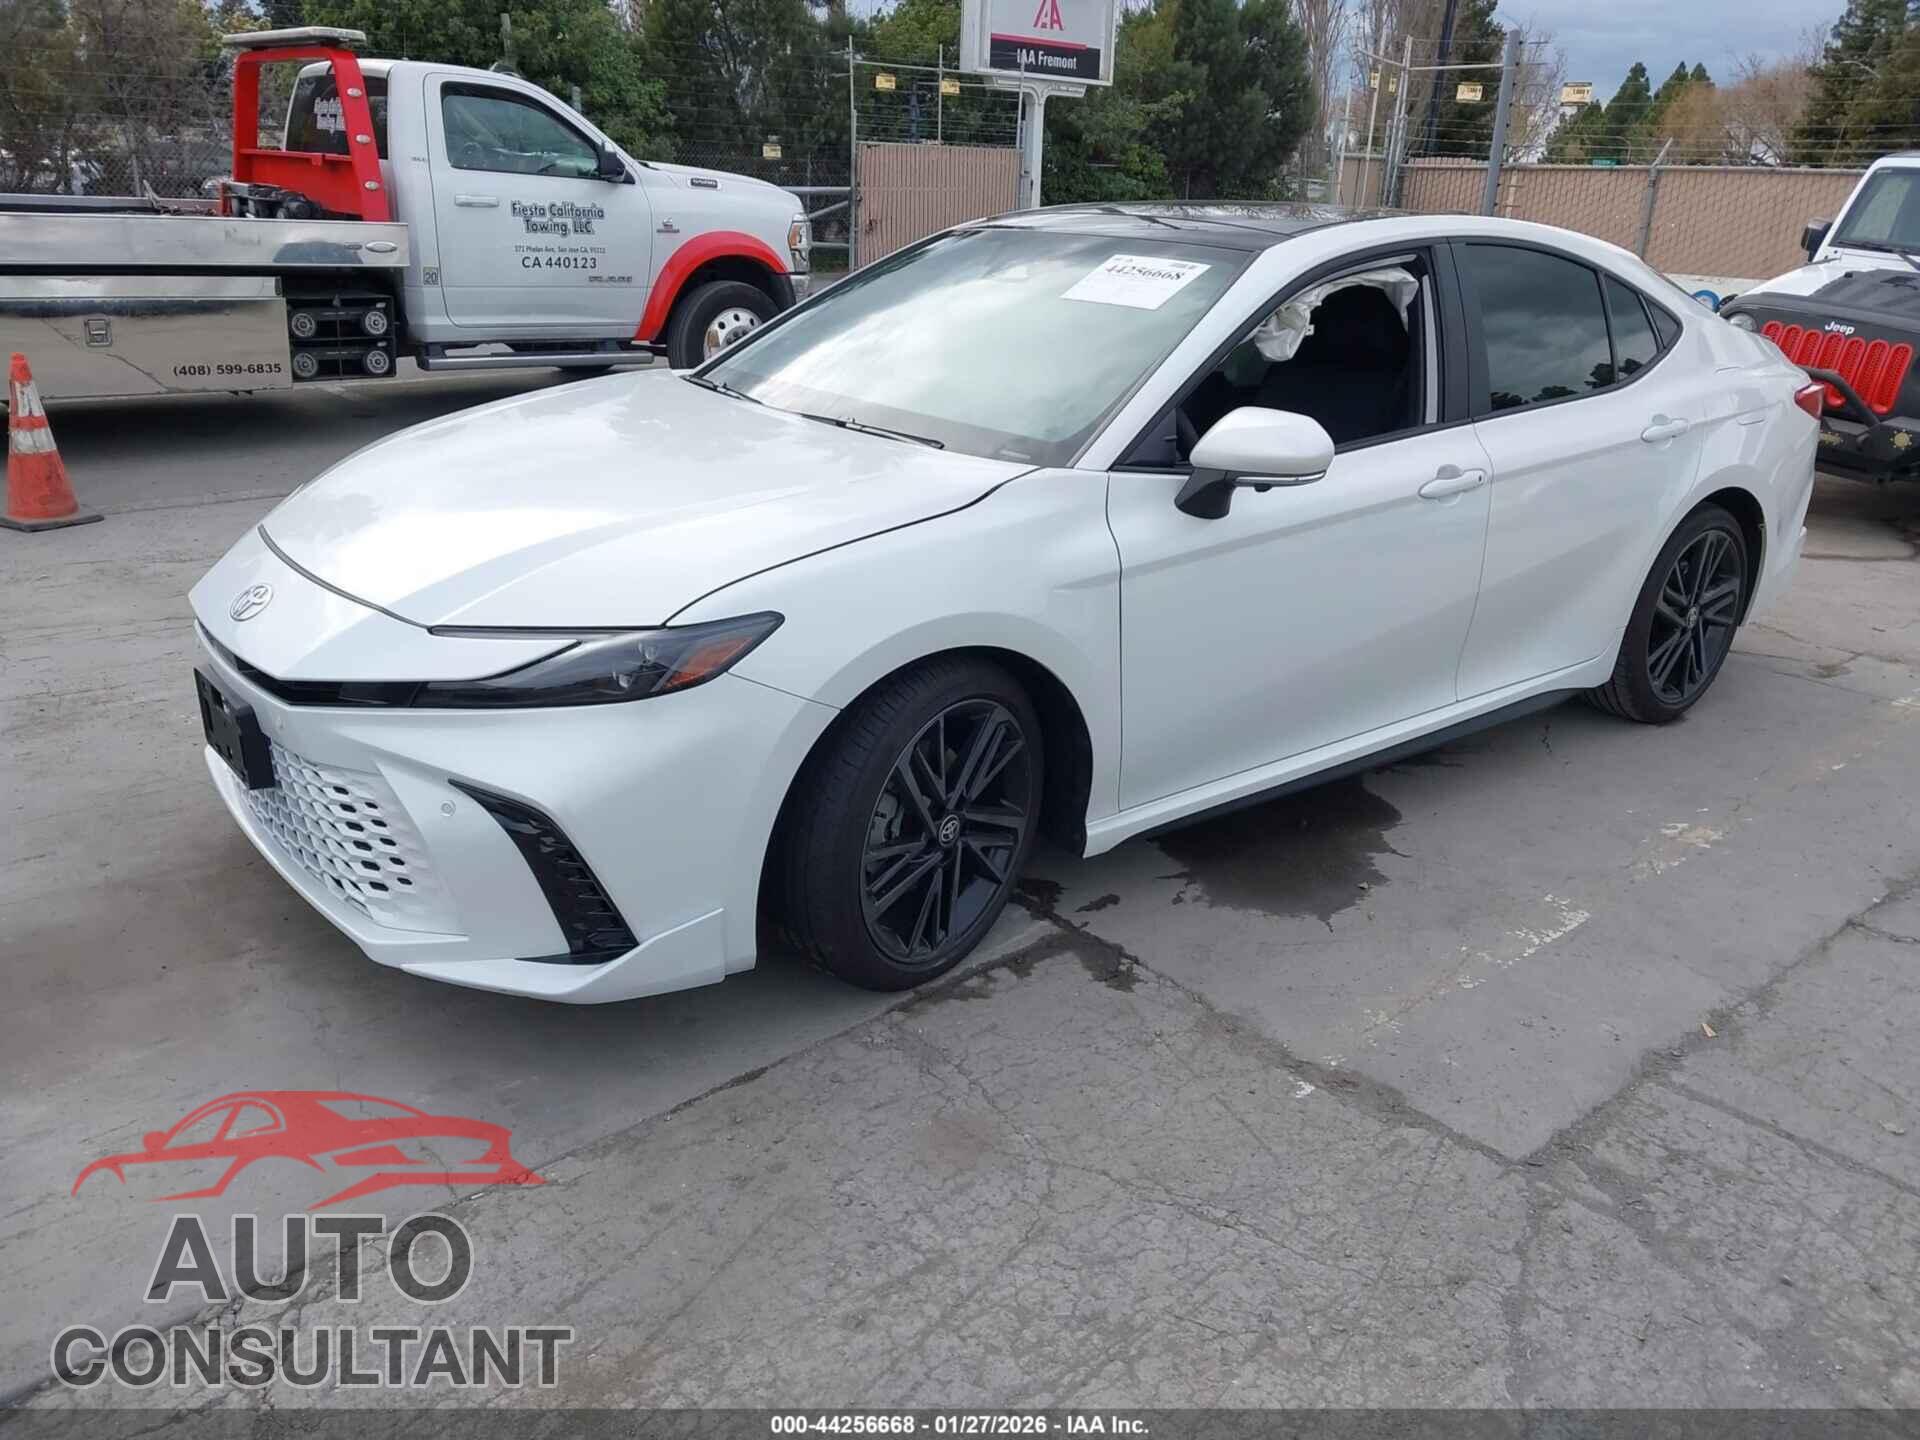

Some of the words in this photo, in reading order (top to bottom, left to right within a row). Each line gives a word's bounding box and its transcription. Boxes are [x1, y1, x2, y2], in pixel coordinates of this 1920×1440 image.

[1016, 48, 1036, 65] IAA
[1038, 50, 1077, 70] Fremont
[511, 201, 546, 217] Fiesta
[549, 202, 605, 219] California
[522, 256, 541, 268] CA
[545, 256, 597, 269] 440123
[1825, 321, 1855, 335] Jeep
[173, 365, 211, 376] (408)
[216, 363, 282, 375] 599-6835
